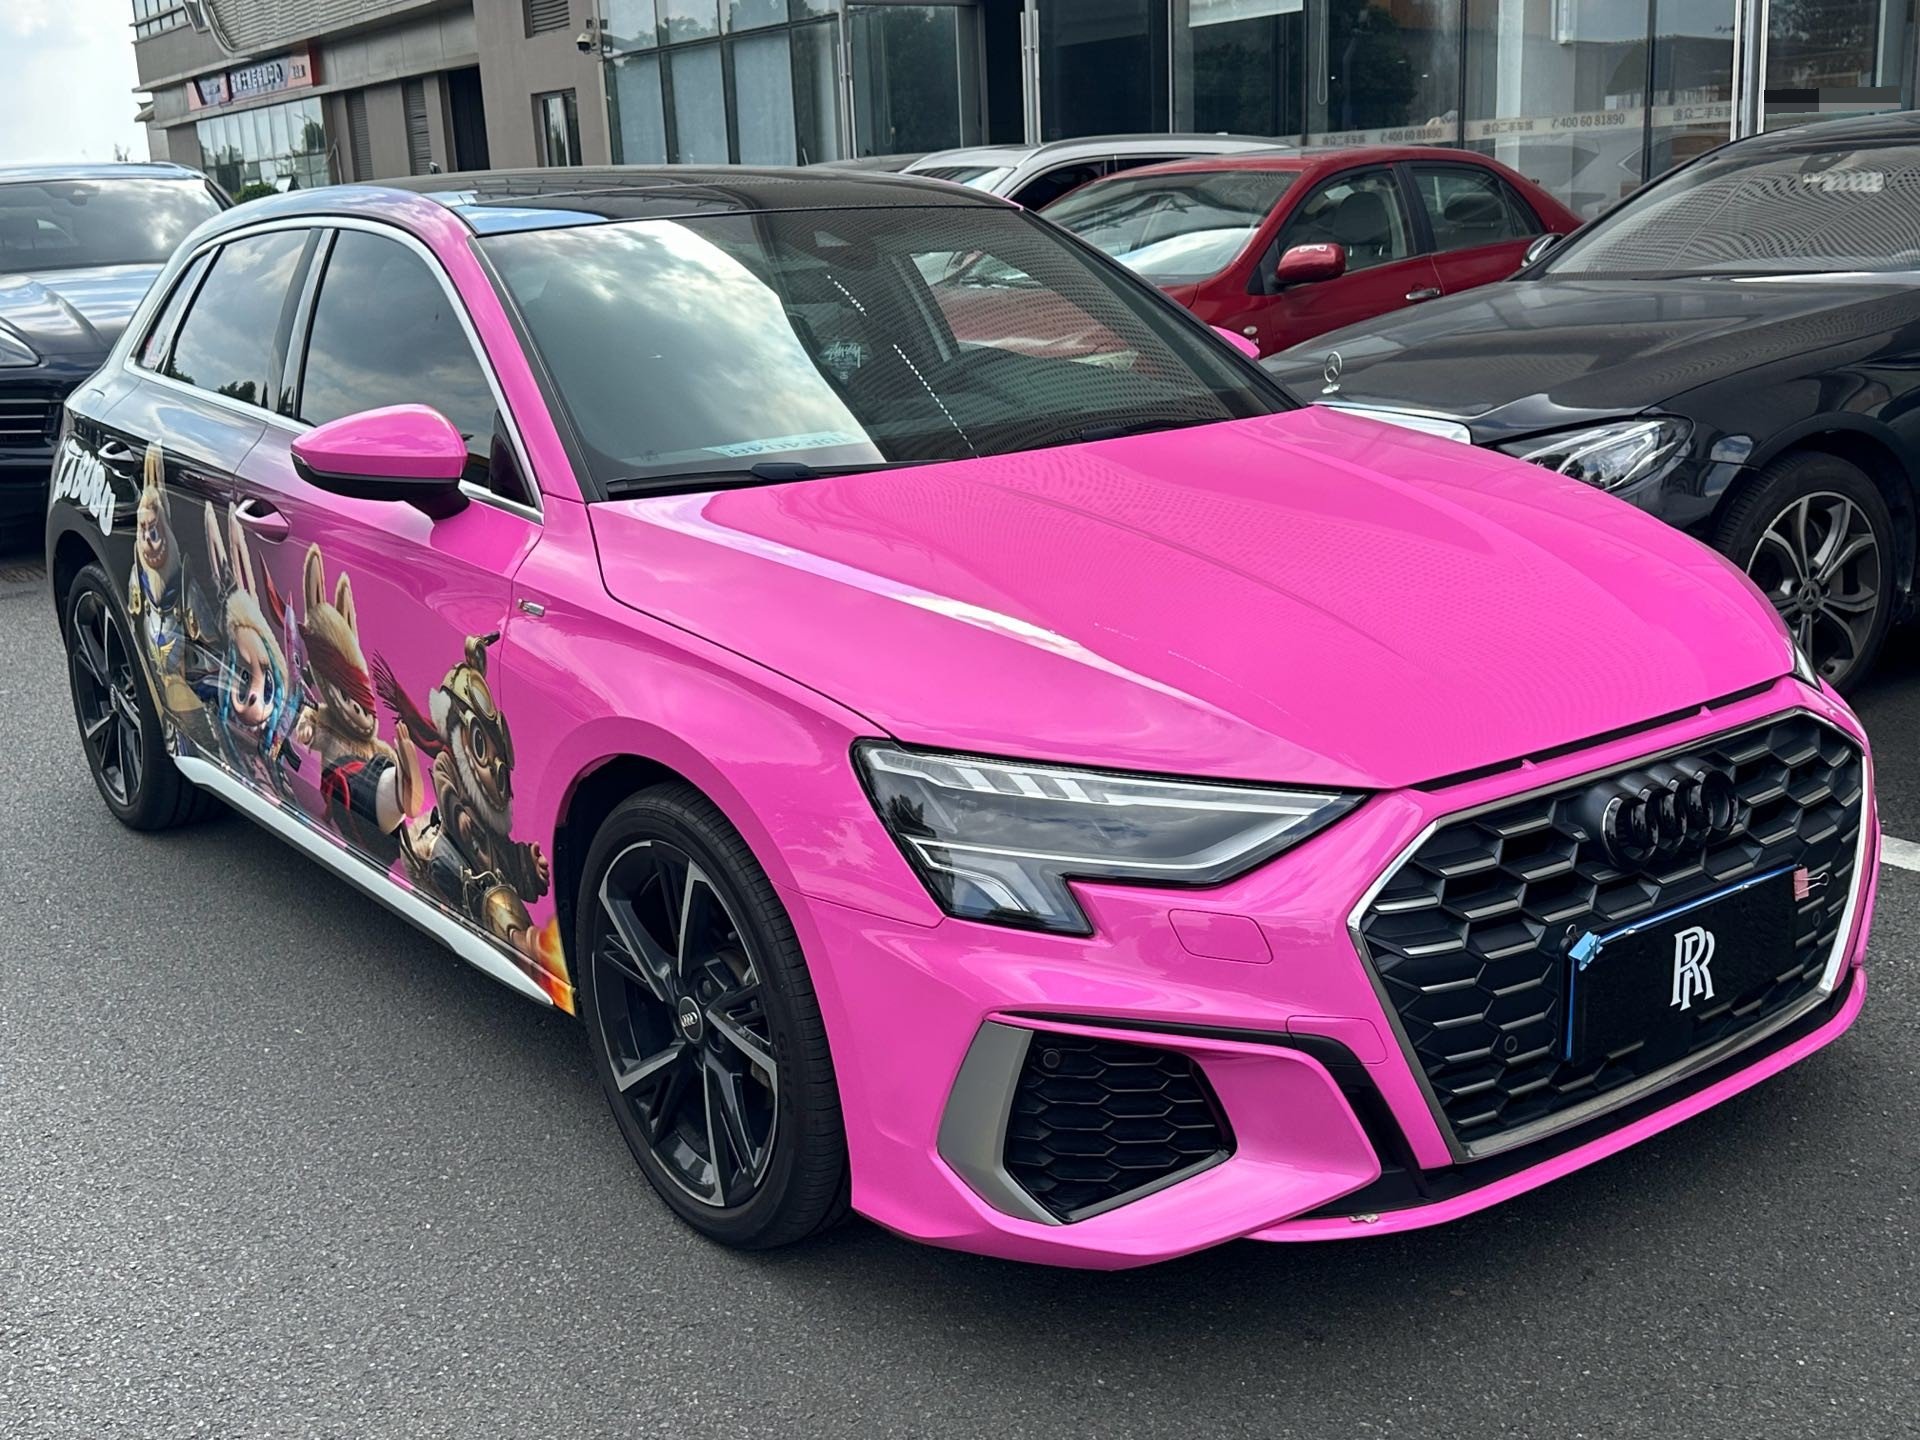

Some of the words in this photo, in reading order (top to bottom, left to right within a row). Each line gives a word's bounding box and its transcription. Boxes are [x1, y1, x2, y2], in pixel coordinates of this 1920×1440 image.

[1560, 117, 1578, 128] 400
[1580, 115, 1593, 127] 60
[1594, 113, 1625, 126] 81890
